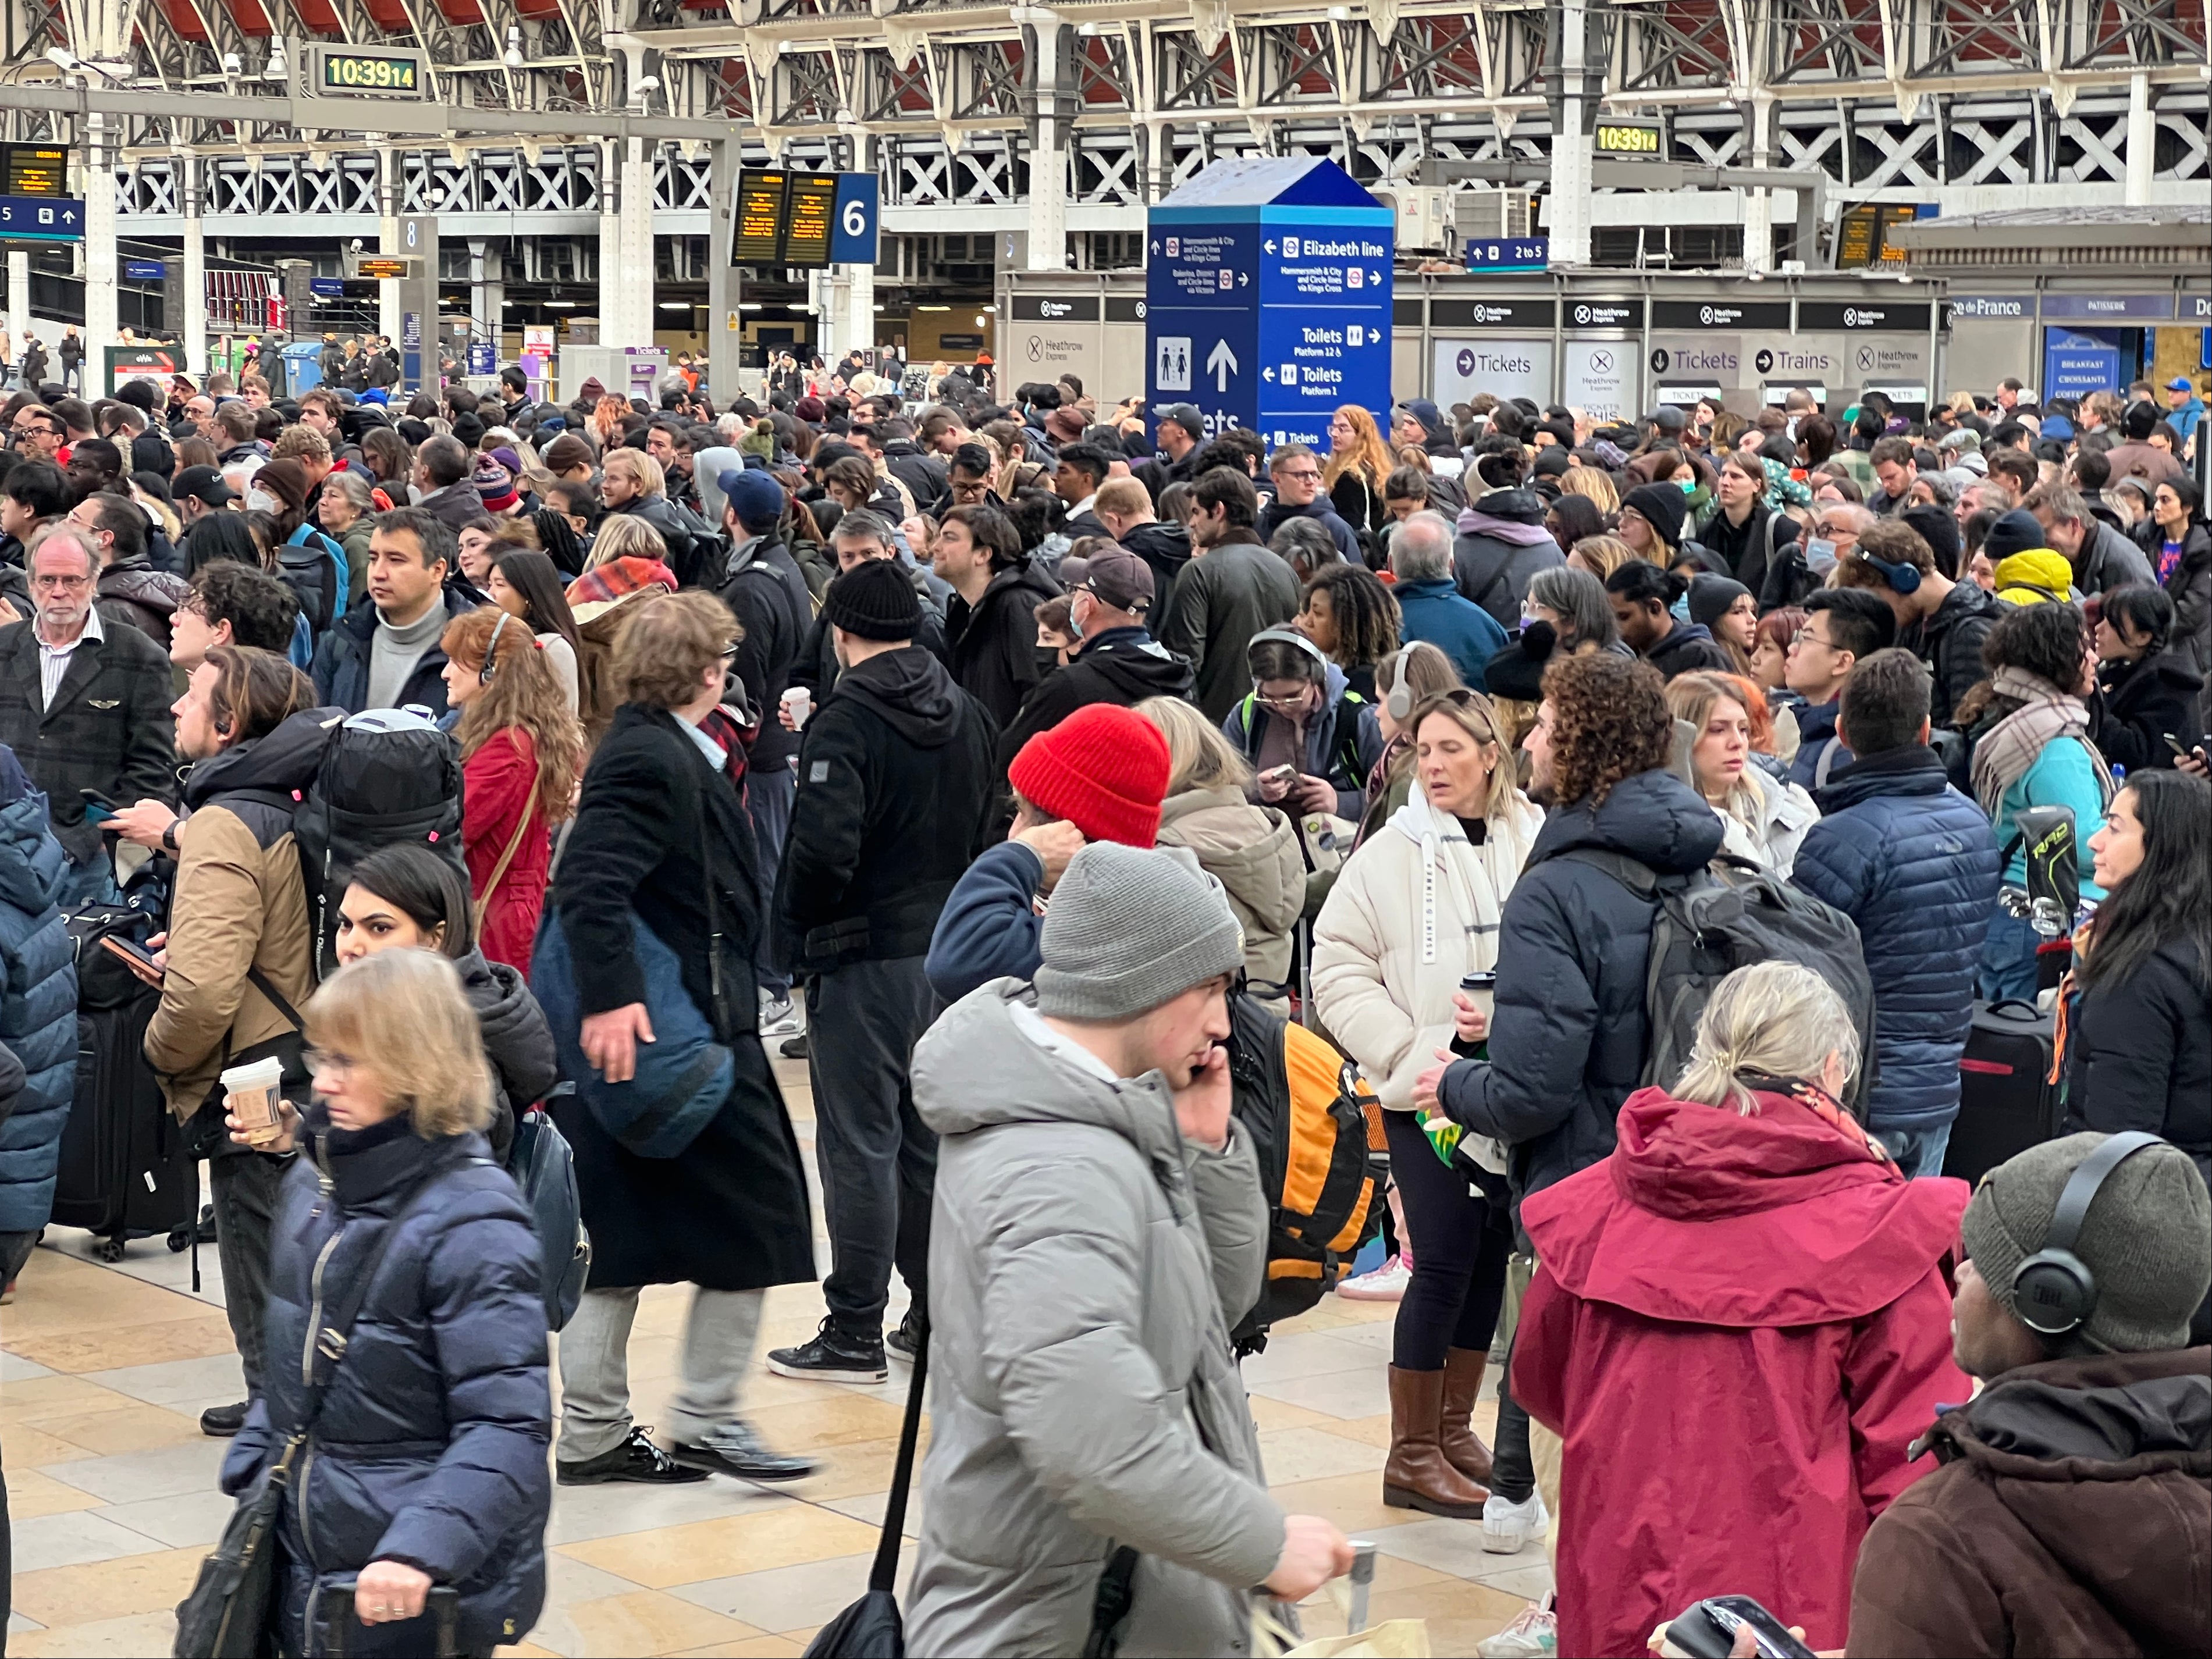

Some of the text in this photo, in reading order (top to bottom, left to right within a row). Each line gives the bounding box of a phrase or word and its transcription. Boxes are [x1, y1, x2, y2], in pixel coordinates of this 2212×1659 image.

[2, 207, 12, 221] 5
[843, 200, 865, 237] 6
[407, 220, 415, 247] 8
[1304, 240, 1384, 257] Elizabeth line
[1516, 245, 1542, 259] 2 to 5
[1281, 266, 1324, 276] Hammersmith
[1329, 266, 1342, 277] City
[1297, 275, 1342, 284] and Circle lines
[1297, 284, 1307, 293] via
[1325, 284, 1342, 293] Cross
[1592, 307, 1630, 317] Heathrow
[1966, 301, 1976, 314] de
[1977, 298, 2021, 315] France
[2088, 300, 2125, 311] PATISSERIE
[1302, 327, 1342, 343] Toilets
[1045, 339, 1083, 351] Heathrow
[1294, 347, 1335, 357] Platform 12
[1878, 350, 1919, 361] Heathrow
[1478, 354, 1531, 373] Tickets
[1674, 349, 1737, 370] Tickets
[1777, 350, 1829, 369] Trains
[2061, 359, 2104, 369] BREAKFAST
[1301, 366, 1342, 383] Toilets
[2058, 375, 2106, 384] CROISSANTS
[1301, 386, 1338, 396] Platform 1
[1288, 432, 1319, 444] Tickets
[2032, 822, 2068, 859] RAD
